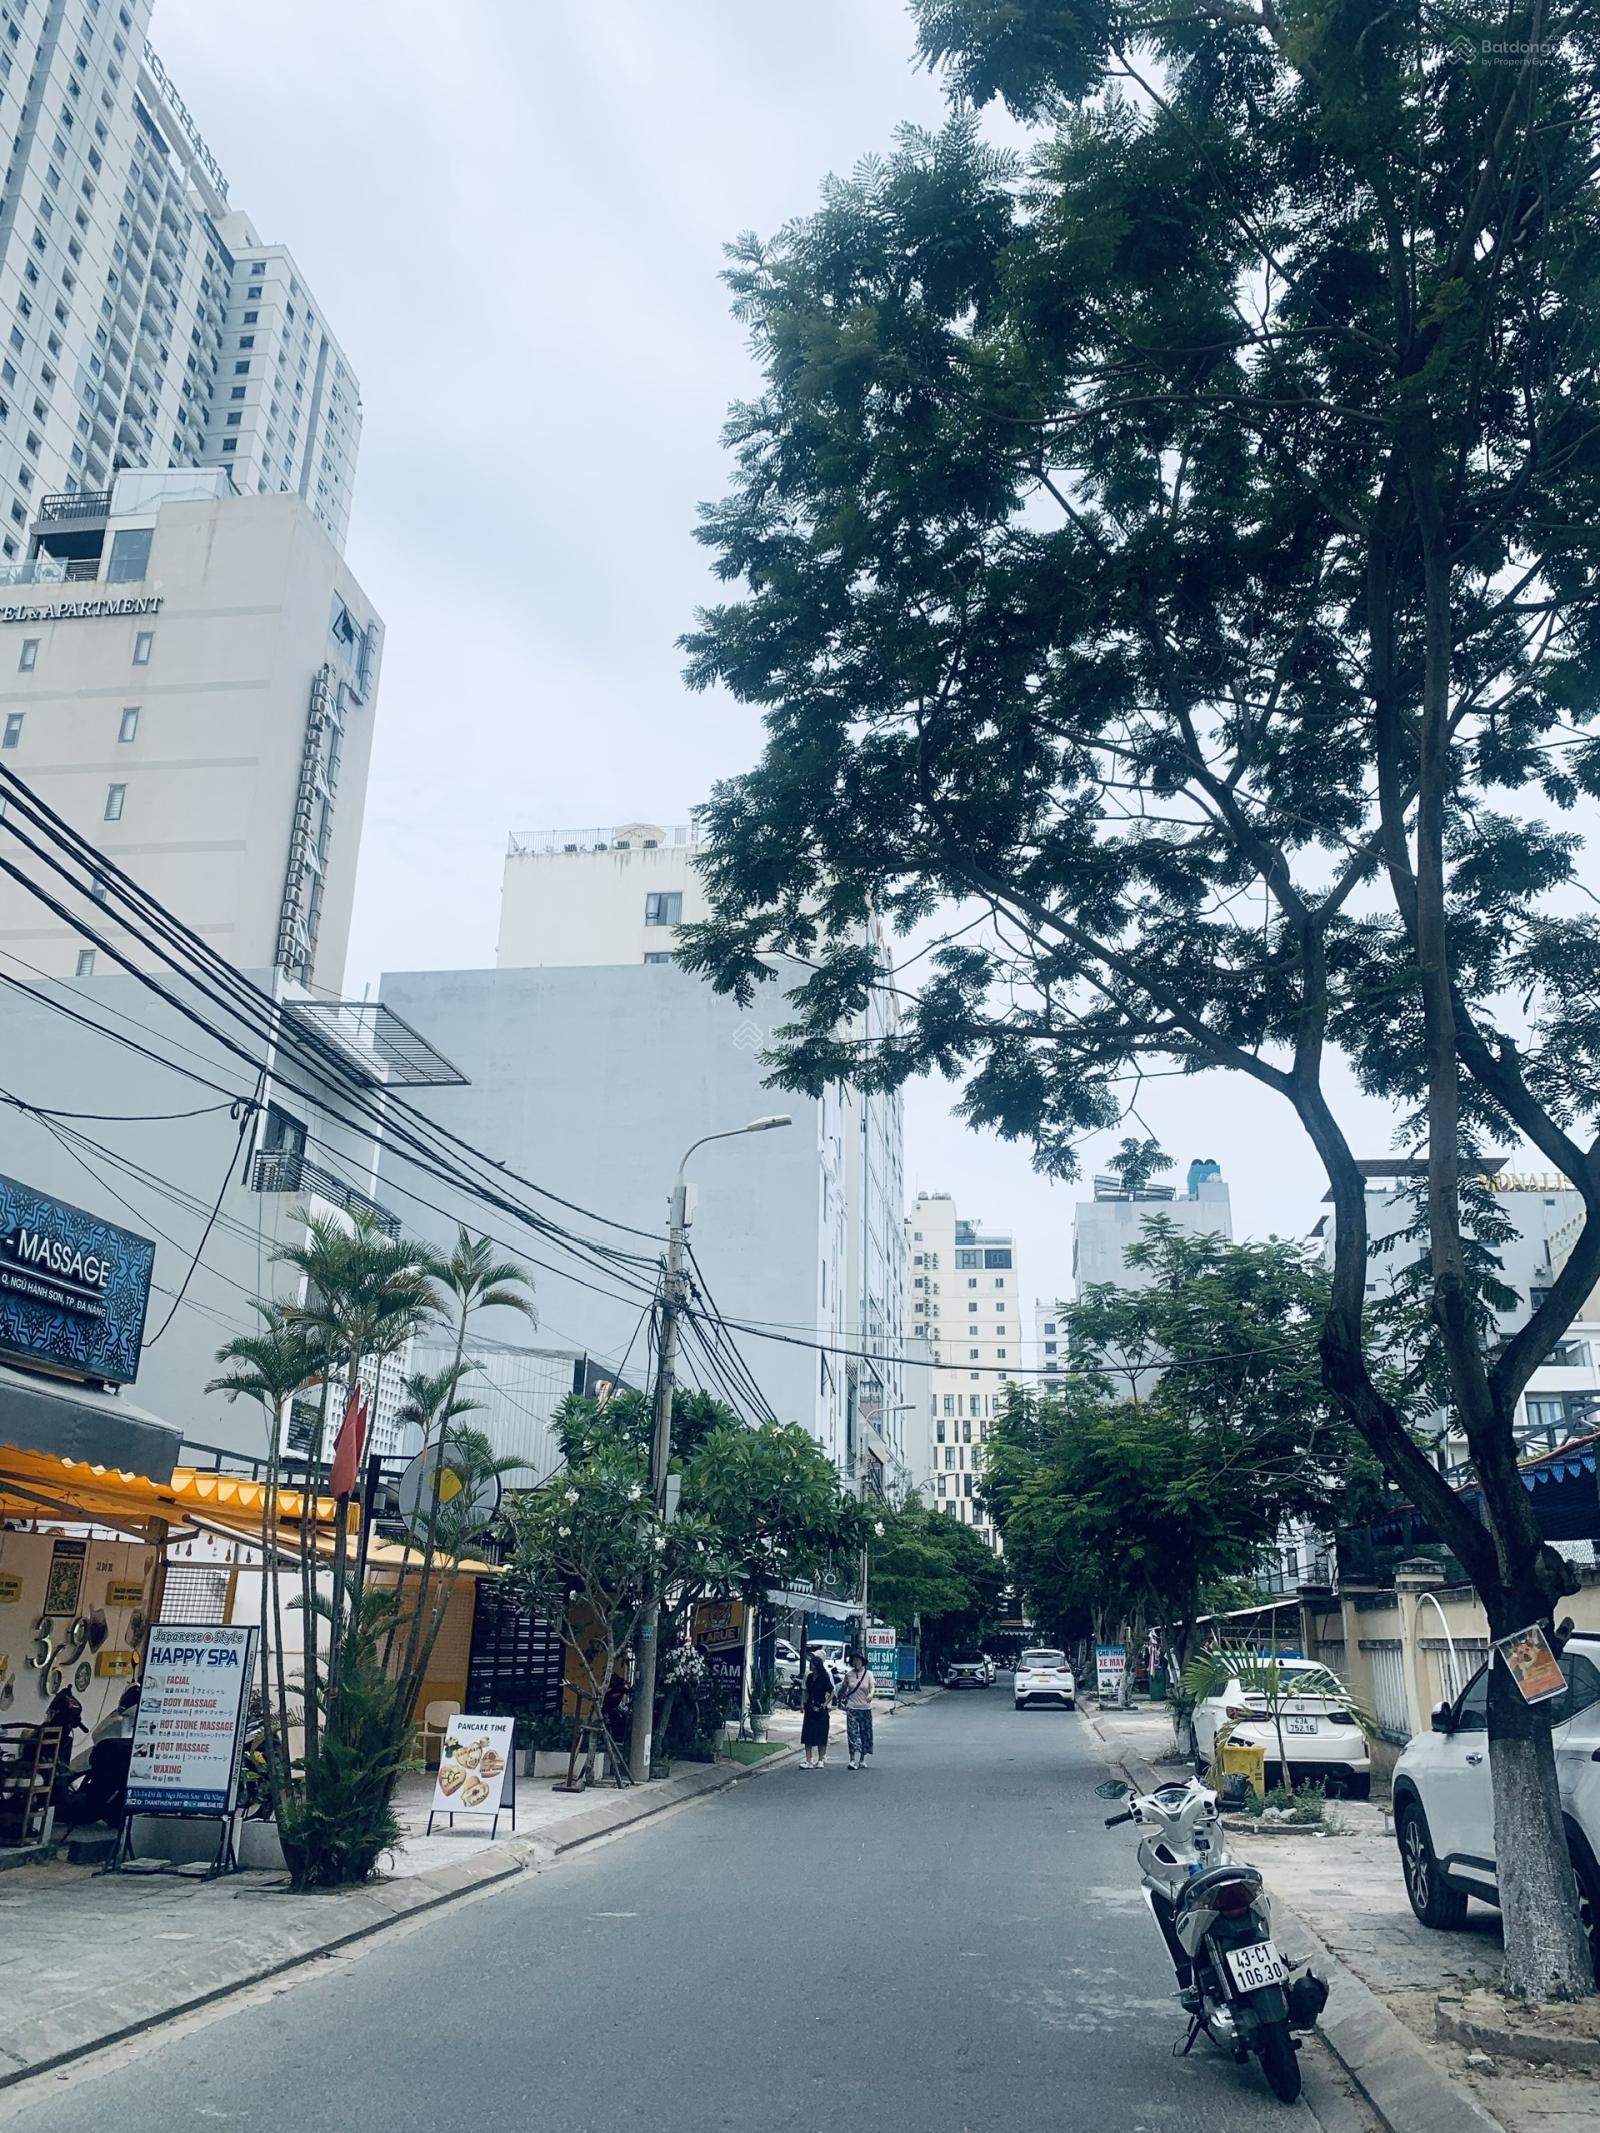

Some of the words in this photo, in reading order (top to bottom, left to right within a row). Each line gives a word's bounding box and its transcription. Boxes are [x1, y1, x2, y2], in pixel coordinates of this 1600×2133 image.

[0, 605, 28, 622] EL
[30, 607, 40, 621] &
[43, 597, 163, 619] APARTMENT
[18, 1229, 111, 1288] MASSAGE
[153, 1629, 204, 1644] Japanese
[213, 1630, 244, 1645] Style
[699, 1628, 736, 1645] LARUE
[868, 1635, 877, 1644] XE
[150, 1646, 207, 1667] HAPPY
[207, 1648, 240, 1668] SPA
[1099, 1658, 1108, 1667] XE
[166, 1675, 190, 1685] FACIAL
[163, 1698, 181, 1707] BODY
[183, 1699, 217, 1709] MASSAGE
[160, 1719, 174, 1729] HOT
[175, 1720, 199, 1731] STONE
[200, 1721, 234, 1732] MASSAGE
[1294, 1717, 1309, 1725] 43A
[457, 1722, 489, 1732] PANCAKE
[490, 1724, 507, 1732] TIME
[1290, 1724, 1315, 1733] 752.16
[156, 1742, 174, 1752] FOOT
[176, 1743, 210, 1753] MASSAGE
[153, 1764, 182, 1775] WAXING
[1235, 1945, 1271, 1969] 43-C1
[1238, 1963, 1283, 1989] 106.30
